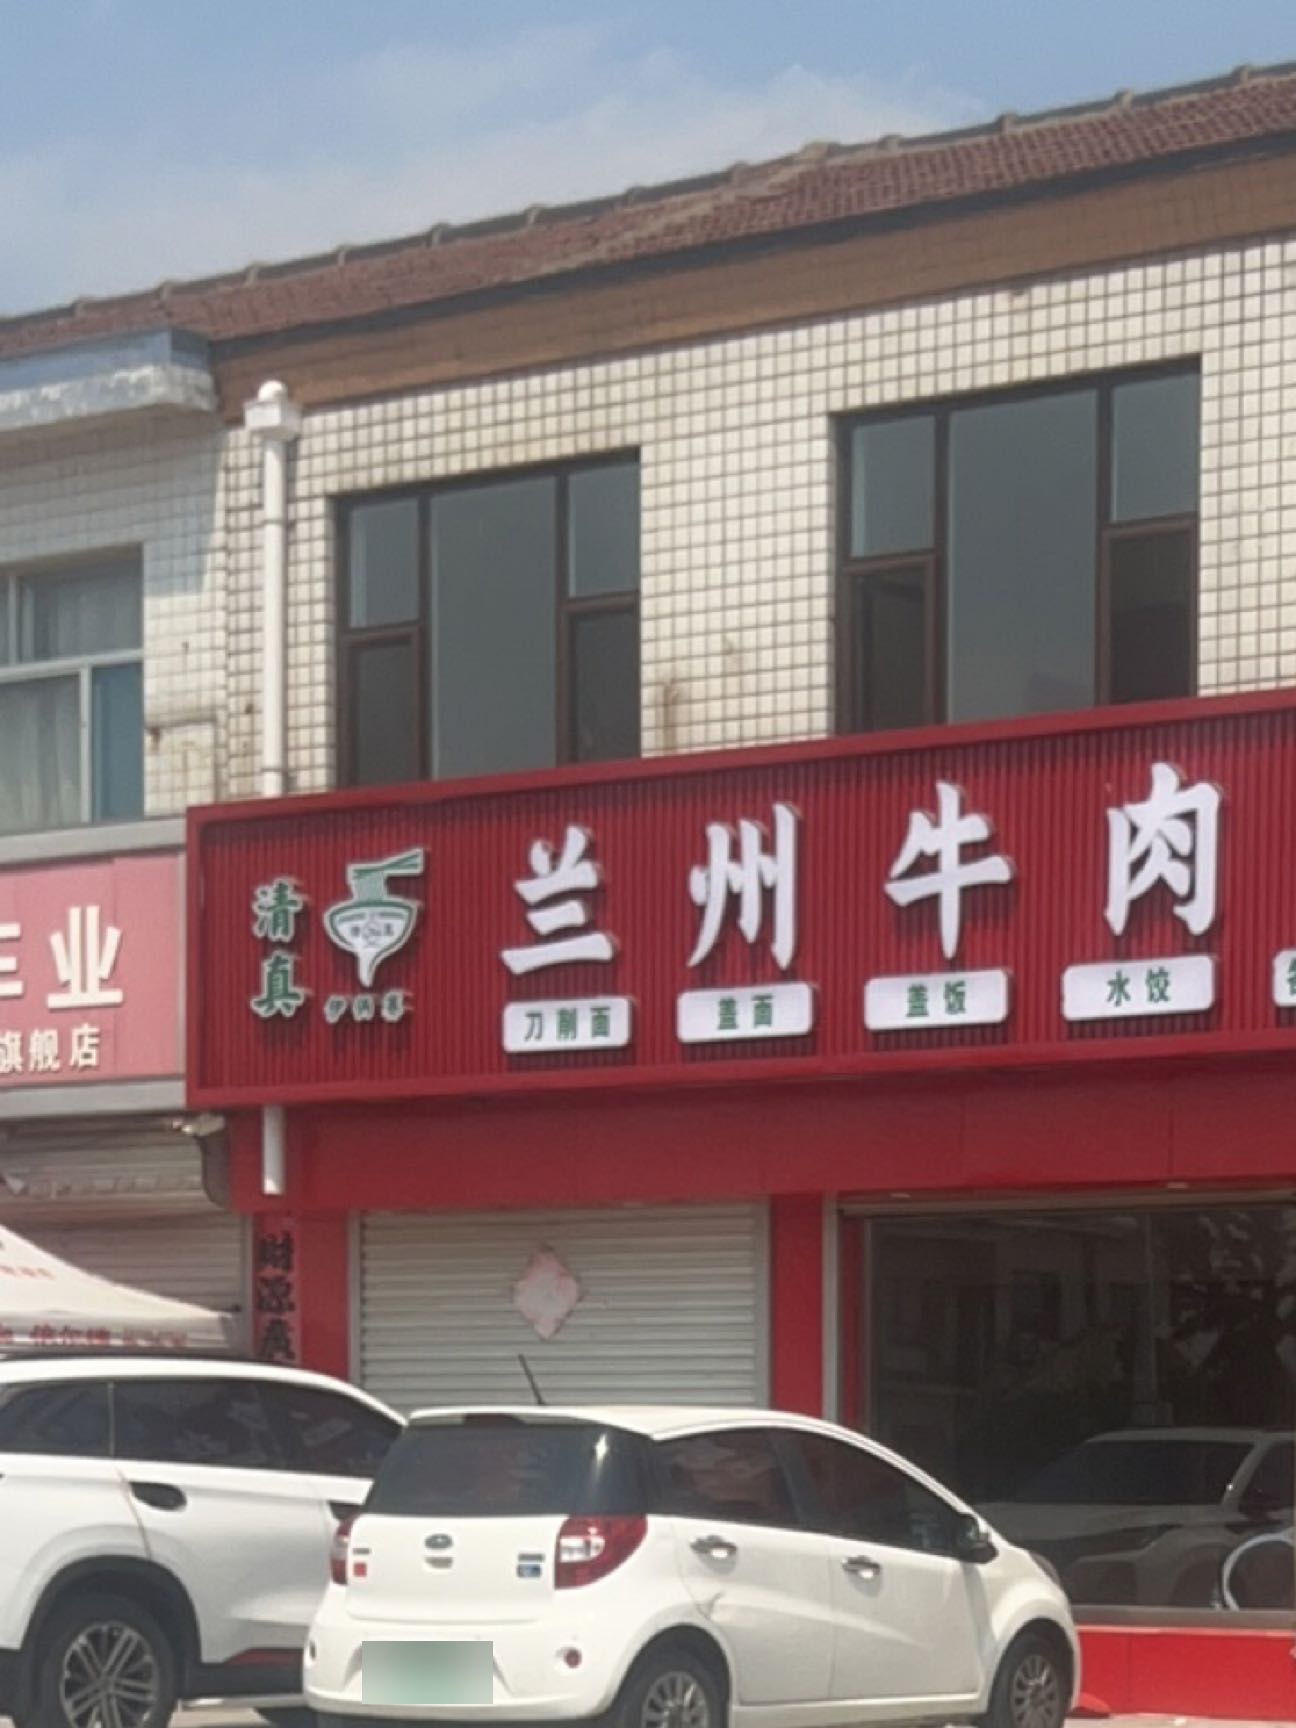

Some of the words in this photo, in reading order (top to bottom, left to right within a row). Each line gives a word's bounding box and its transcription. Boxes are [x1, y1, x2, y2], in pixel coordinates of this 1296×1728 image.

[252, 876, 306, 1018] 清真
[904, 980, 967, 1018] 盖饭
[1105, 966, 1172, 1007] 水饺
[524, 1005, 611, 1042] 刀削面
[717, 994, 774, 1031] 盖面
[0, 1023, 100, 1073] 旗舰店
